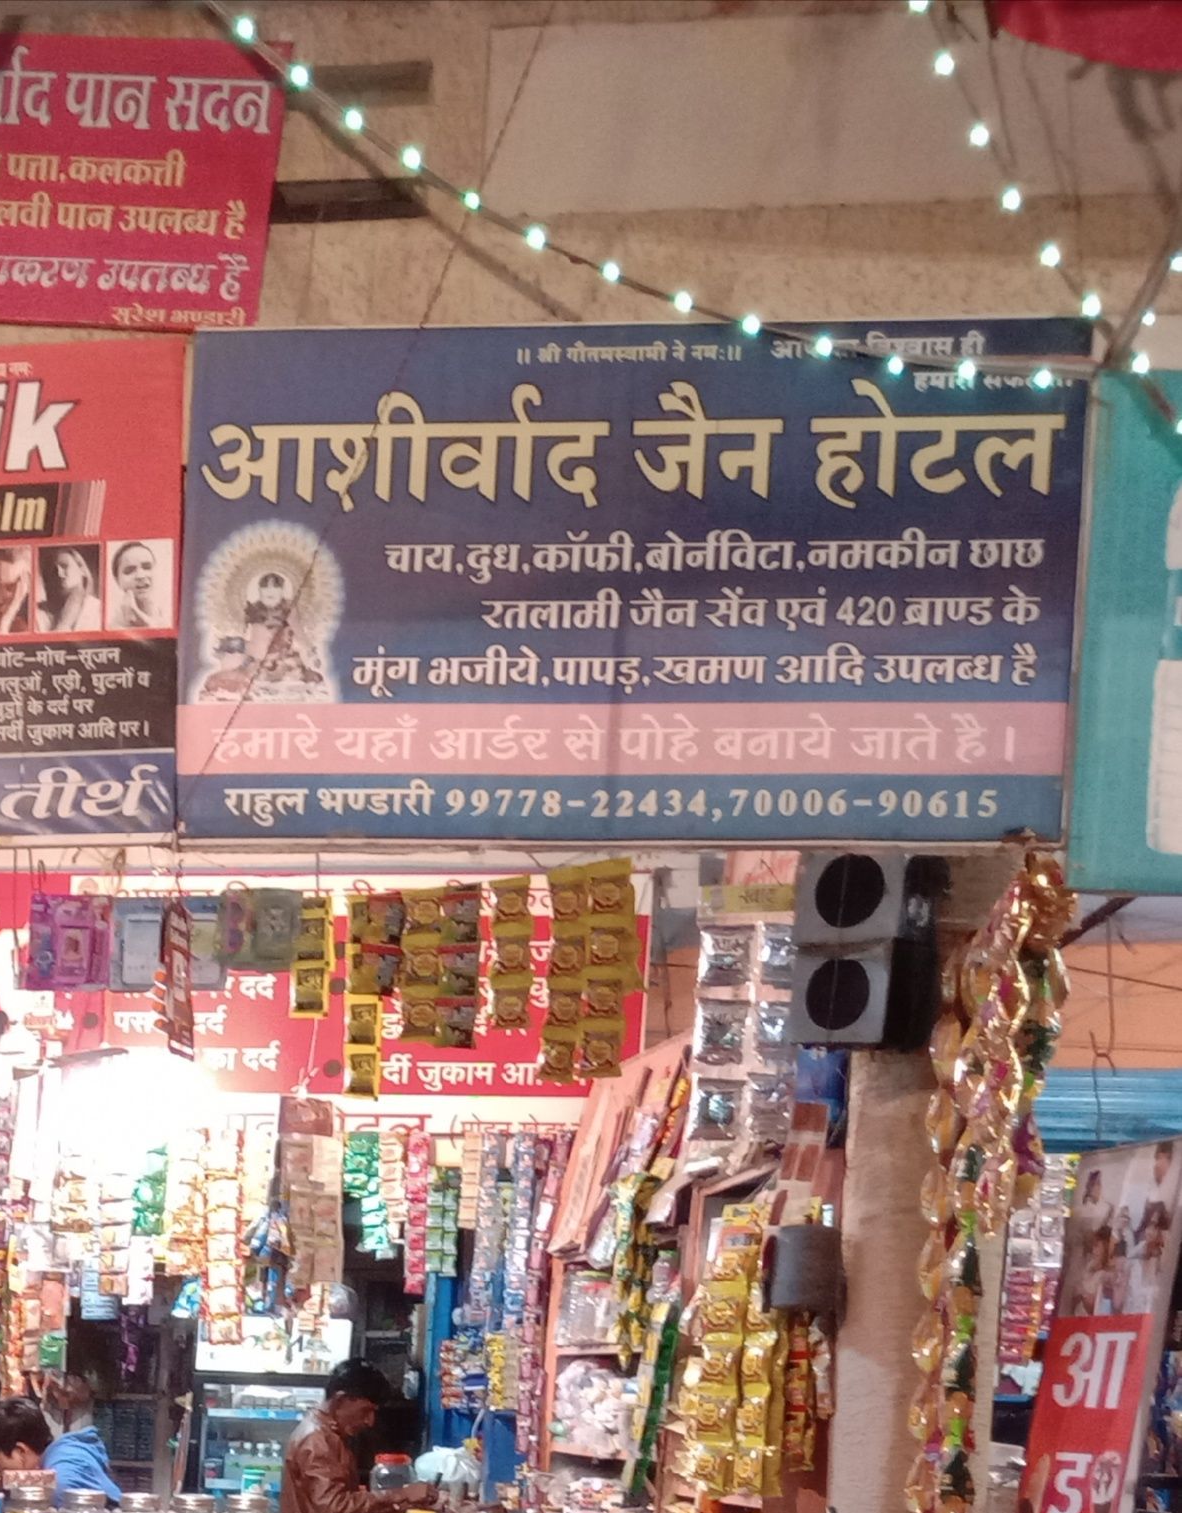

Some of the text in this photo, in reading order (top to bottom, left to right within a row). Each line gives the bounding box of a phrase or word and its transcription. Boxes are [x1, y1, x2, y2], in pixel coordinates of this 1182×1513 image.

[66, 71, 156, 132] पान
[165, 75, 274, 134] सदन
[57, 203, 114, 232] पान
[119, 205, 219, 236] उपलब्ध
[224, 200, 247, 240] है
[218, 253, 250, 302] है
[537, 343, 562, 363] श्री
[201, 378, 1066, 512] आशीर्वाद जैन होटल
[968, 538, 1045, 568] छाछ
[481, 588, 622, 630] रतलामी
[630, 588, 698, 629] जैन
[775, 587, 827, 631] एवं
[836, 596, 896, 626] 420
[903, 597, 993, 627] ब्राण्ड
[1002, 585, 1041, 626] के
[774, 642, 865, 685] आदि
[874, 654, 1004, 684] उपलब्ध
[1011, 642, 1038, 686] है
[212, 712, 941, 763] हमारे यहाँ आर्डर से पोहे बनाये जाते
[0, 763, 162, 821] तीर्थ
[224, 787, 308, 827] राहुल
[316, 779, 434, 818] भण्डारी
[417, 1061, 496, 1091] जुकाम
